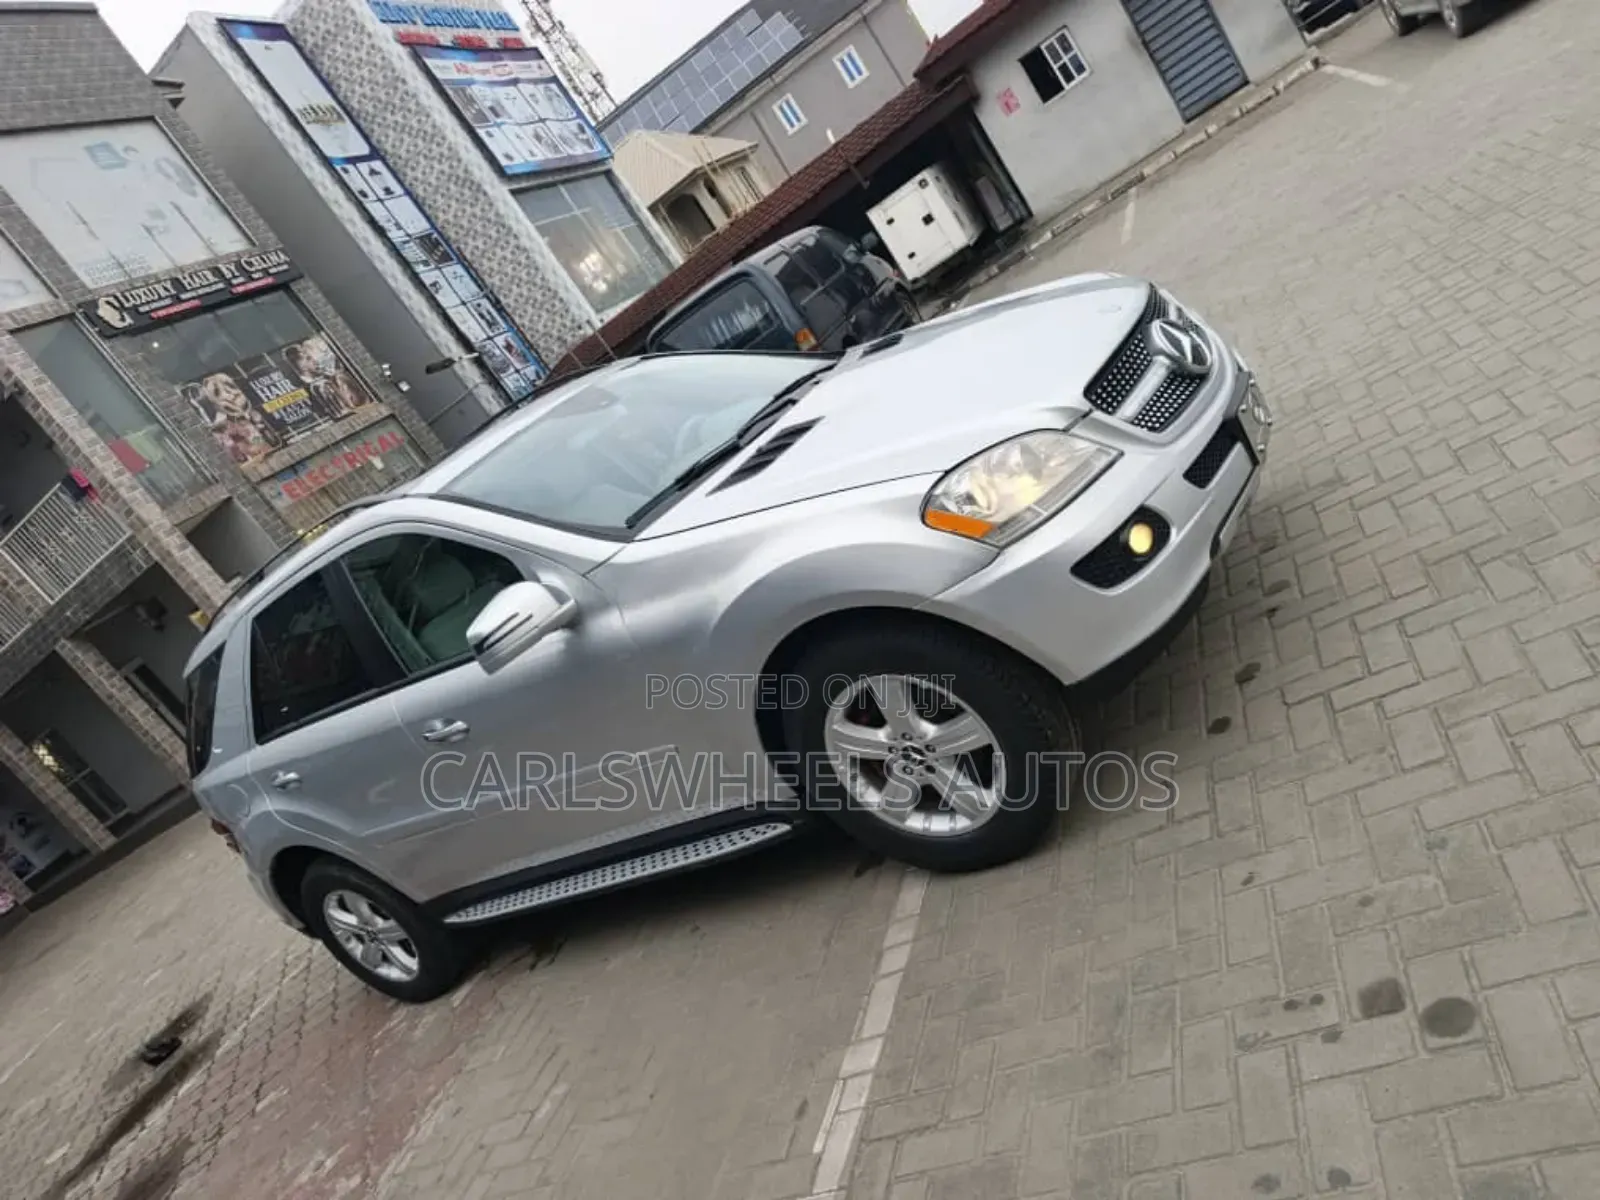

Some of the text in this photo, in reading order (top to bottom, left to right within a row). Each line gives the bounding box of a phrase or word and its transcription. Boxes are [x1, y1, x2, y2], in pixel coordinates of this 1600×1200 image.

[117, 279, 177, 307] LUXURY
[178, 269, 217, 291] HAIR
[240, 250, 291, 271] CELINA
[253, 379, 298, 402] HAIR
[280, 431, 405, 499] ELECTRICAL
